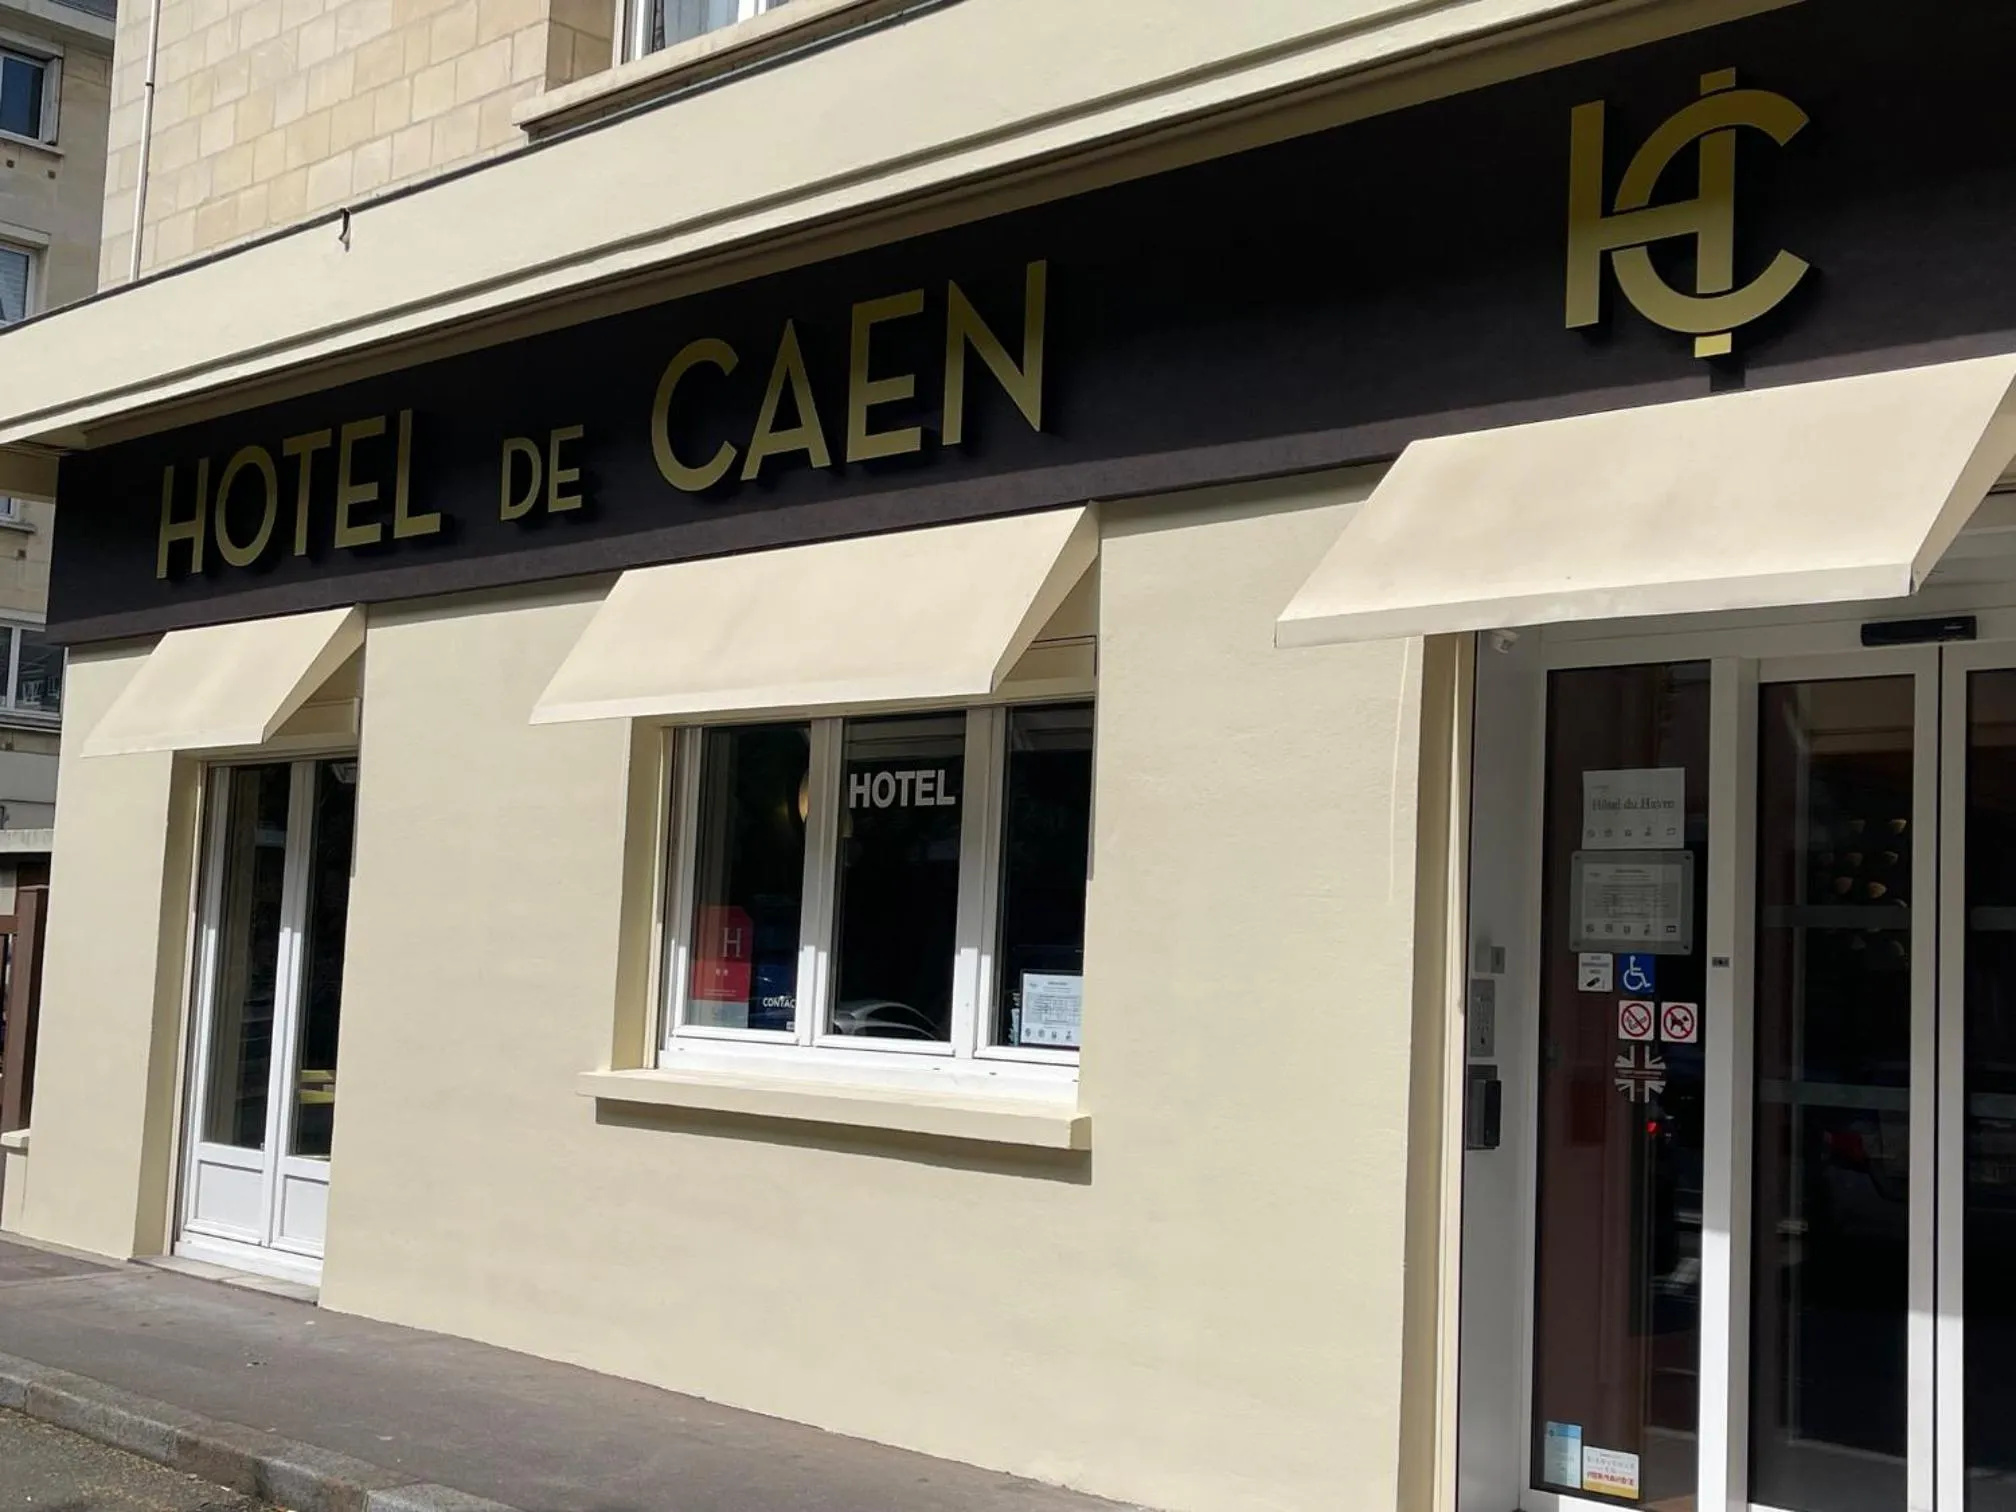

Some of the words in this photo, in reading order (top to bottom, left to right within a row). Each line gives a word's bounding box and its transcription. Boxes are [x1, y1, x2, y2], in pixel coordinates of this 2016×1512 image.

[155, 408, 442, 581] HOTEL
[500, 424, 585, 522] DE
[650, 260, 1048, 493] CAEN
[849, 769, 956, 809] HOTEL
[722, 927, 743, 958] H
